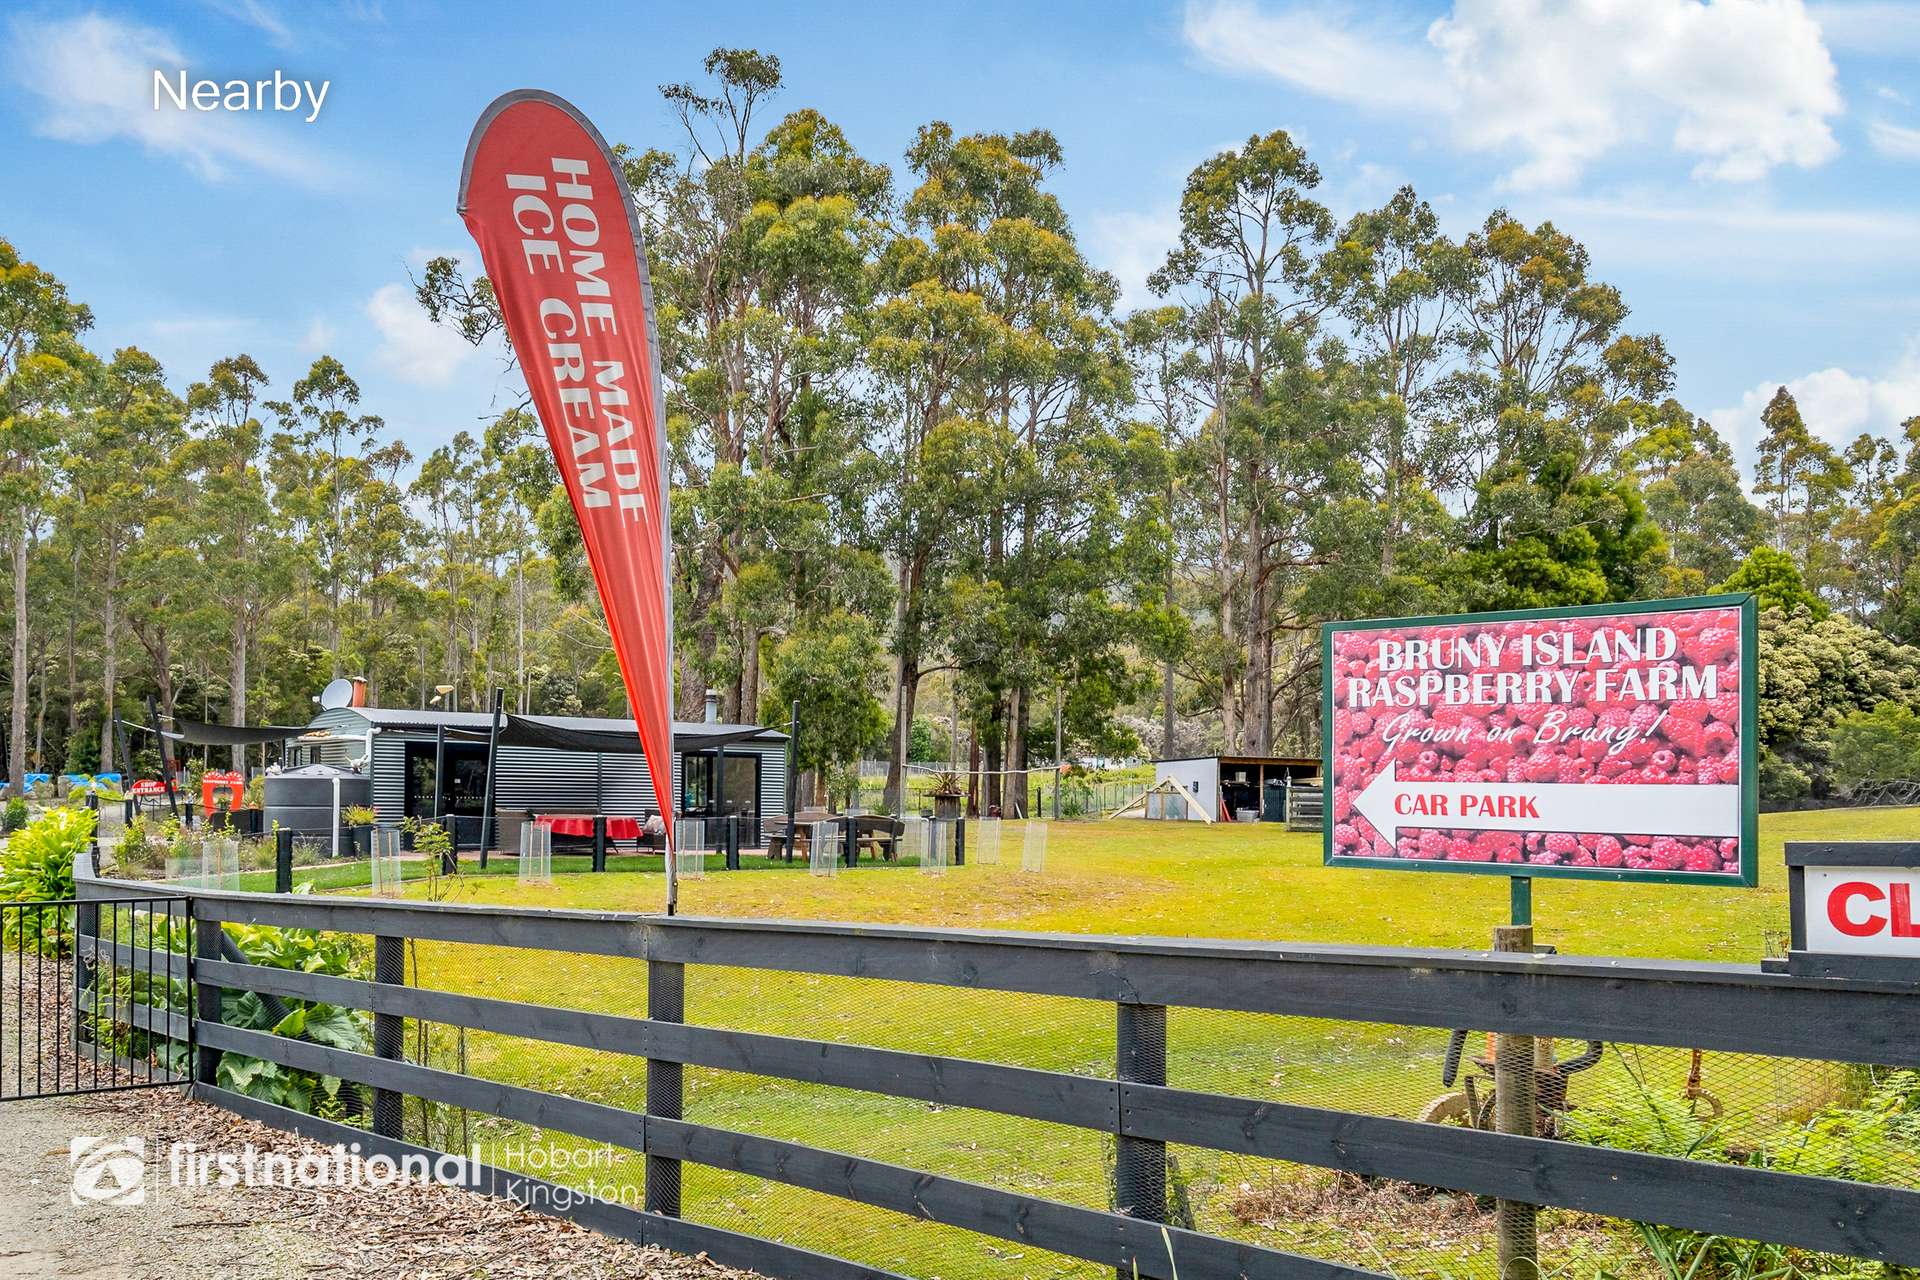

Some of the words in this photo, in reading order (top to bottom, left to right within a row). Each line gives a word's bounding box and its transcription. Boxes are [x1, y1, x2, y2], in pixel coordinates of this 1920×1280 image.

[505, 173, 564, 275] ICE
[539, 297, 612, 508] CREAM
[551, 156, 617, 337] HOME
[592, 359, 649, 529] MADE
[1379, 635, 1507, 672] BRUNY
[1522, 627, 1677, 666] ISLAND
[1349, 672, 1580, 708] RASPBERRY
[1595, 664, 1718, 702] FARM
[1383, 713, 1473, 753] Grown
[1486, 727, 1521, 744] on
[1533, 709, 1668, 756] Bruny!
[1394, 793, 1448, 816] CAR
[1460, 794, 1540, 818] PARK
